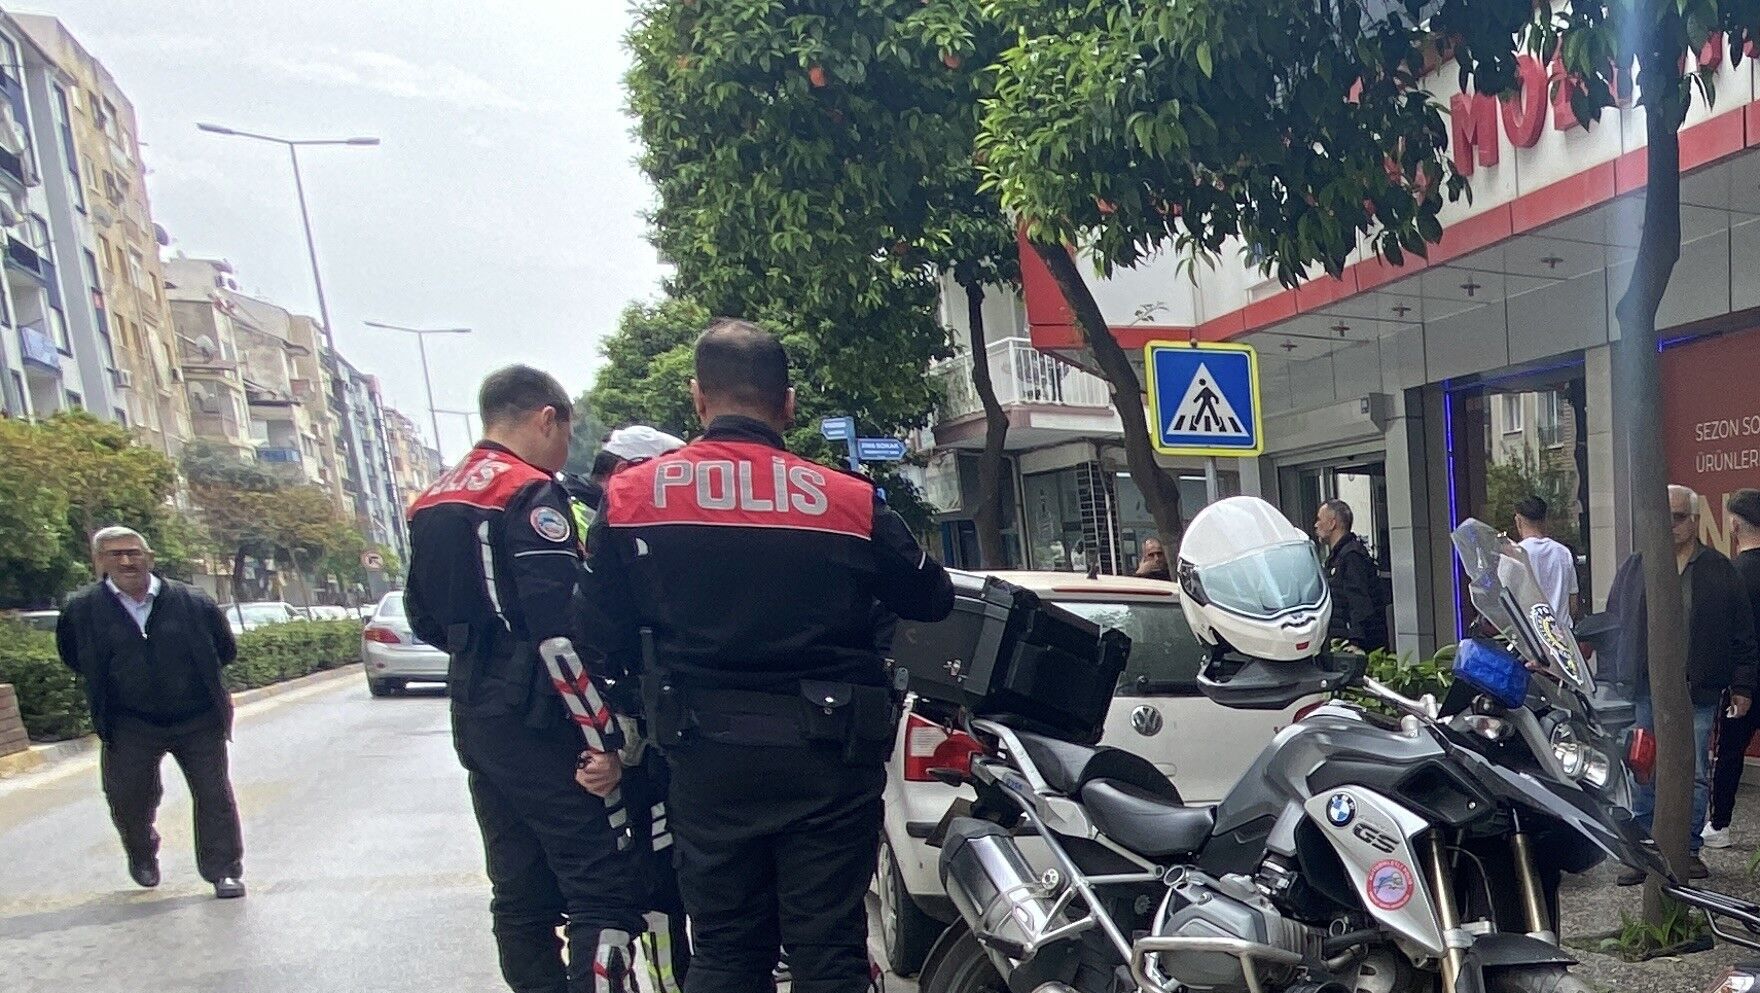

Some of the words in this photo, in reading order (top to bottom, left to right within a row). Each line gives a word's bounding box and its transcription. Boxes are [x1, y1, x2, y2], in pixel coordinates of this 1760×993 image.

[1695, 419, 1739, 442] SEZON
[654, 455, 828, 516] POLİS
[1353, 822, 1400, 853] GS
